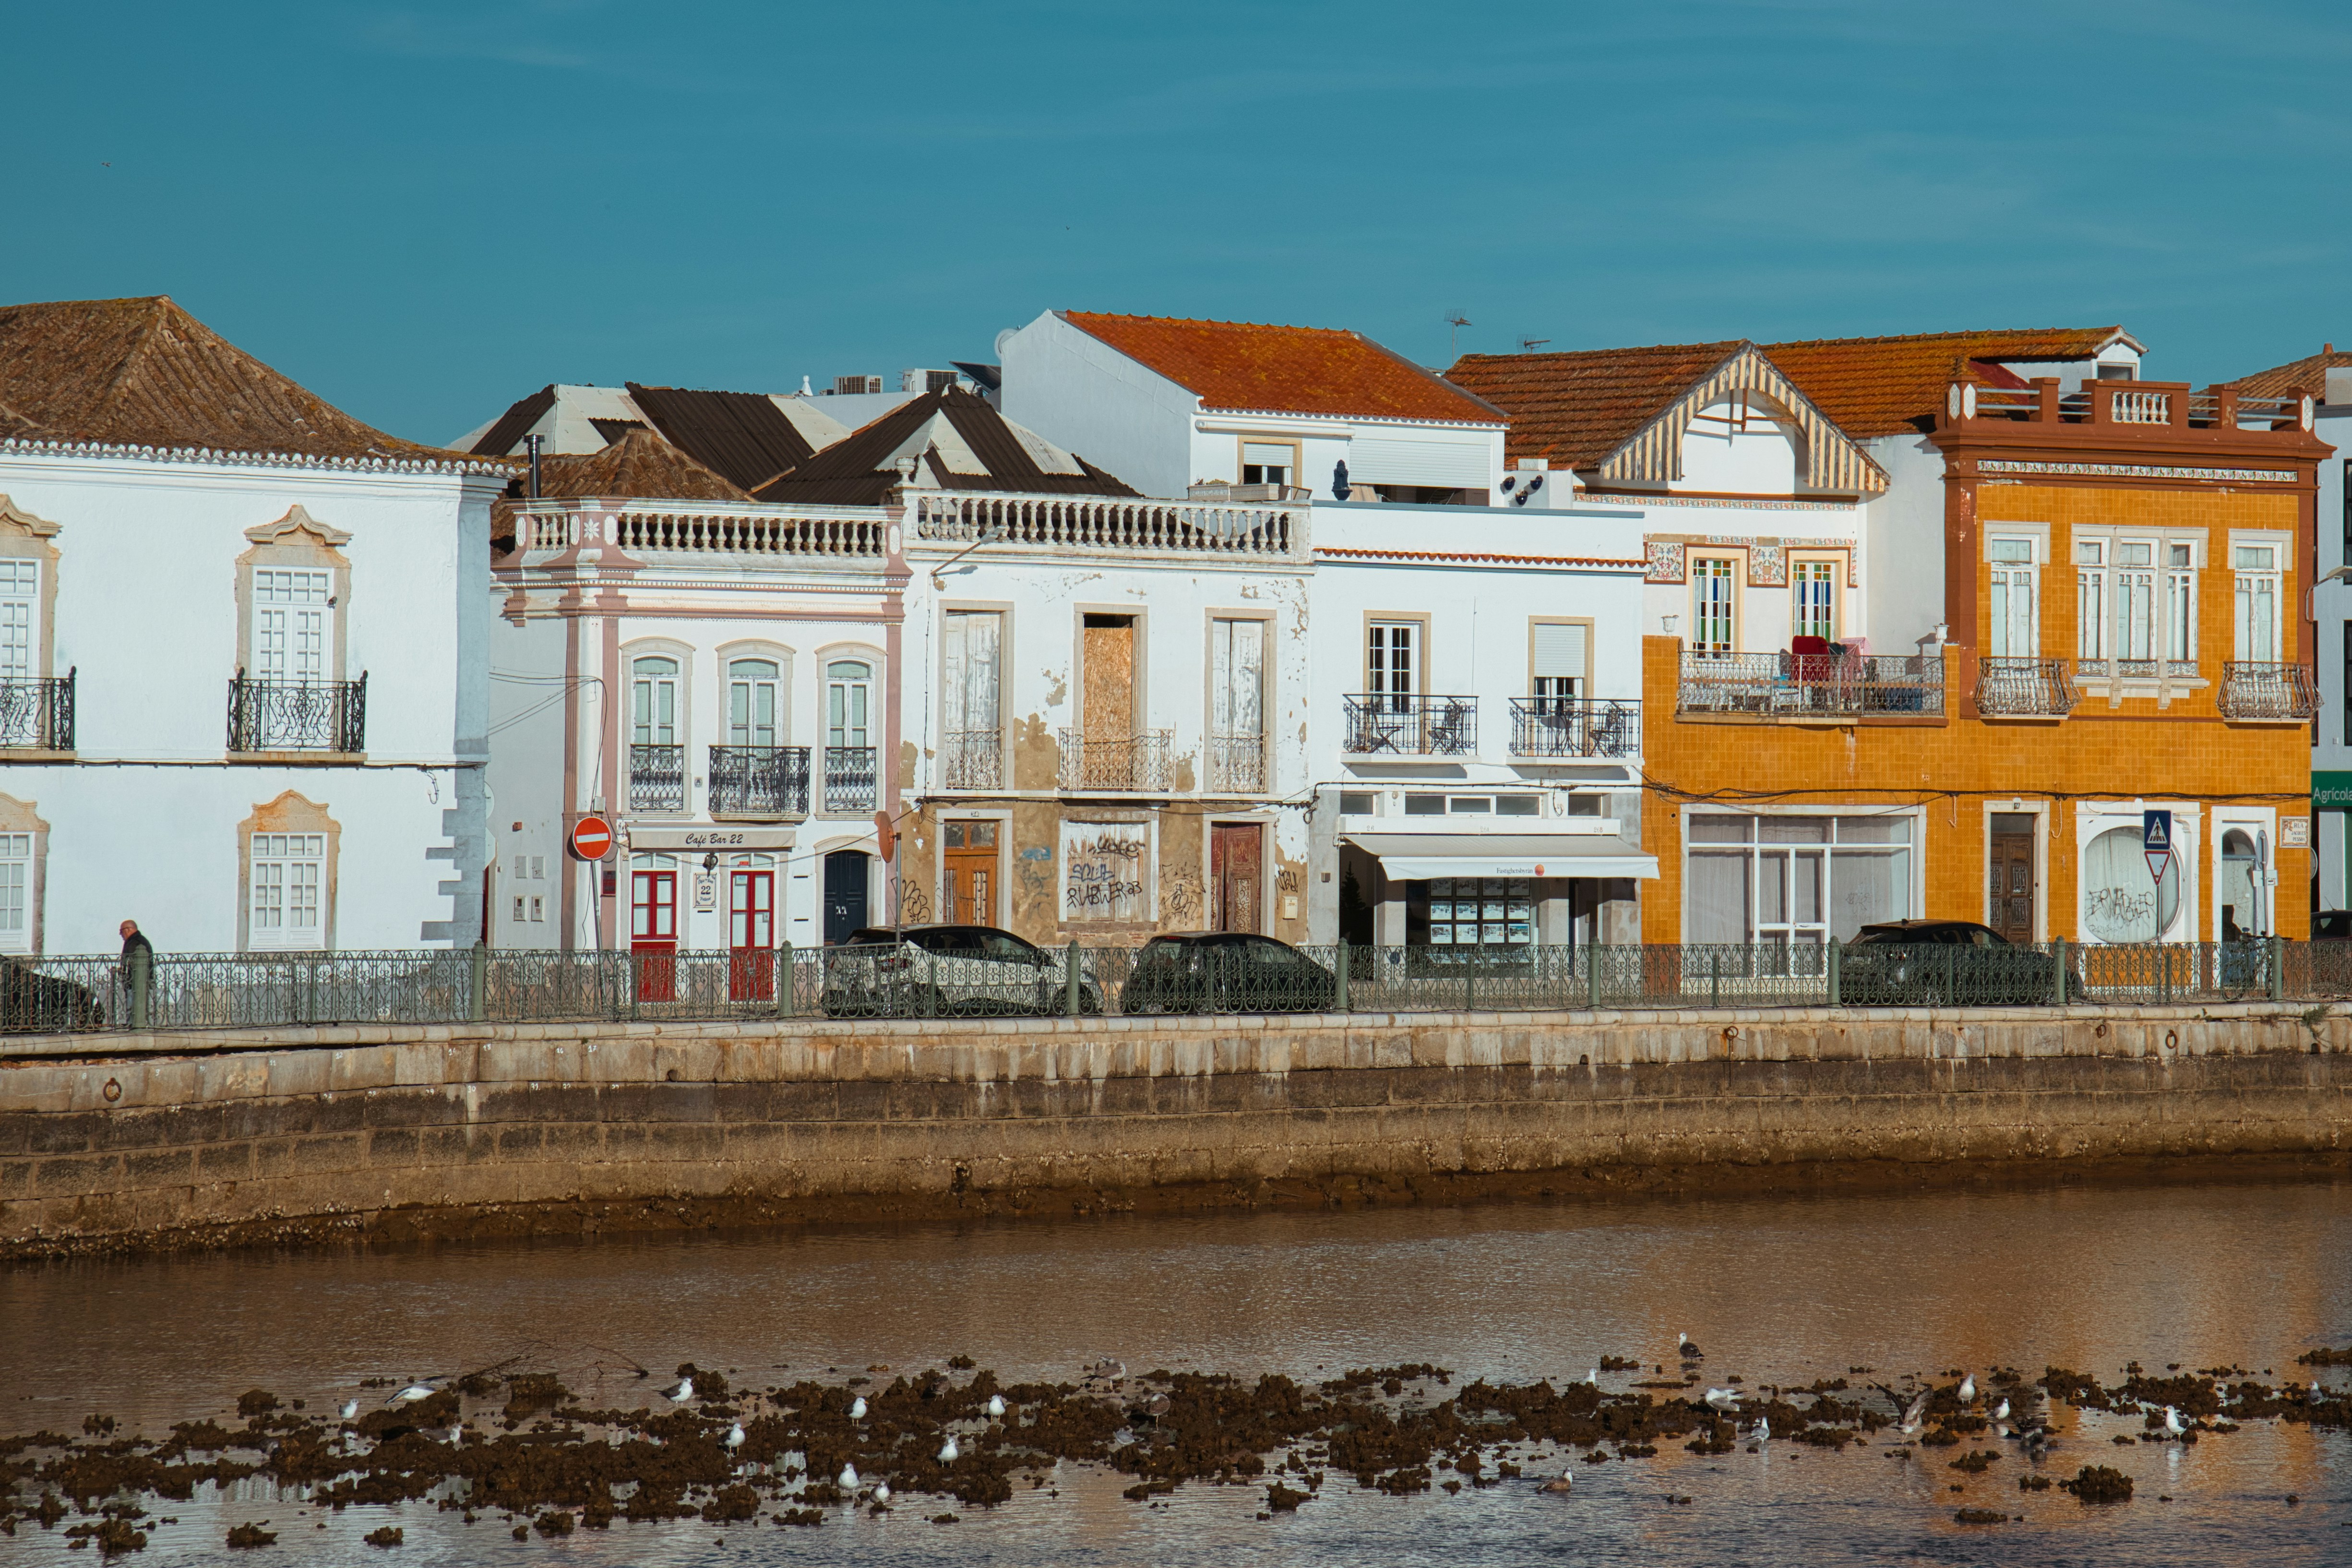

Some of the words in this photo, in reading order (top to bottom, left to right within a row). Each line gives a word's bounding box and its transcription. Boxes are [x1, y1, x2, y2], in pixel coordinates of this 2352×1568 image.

[686, 833, 706, 847] Café
[710, 833, 727, 844] Bar
[730, 834, 743, 844] 22
[701, 886, 711, 895] 22
[335, 1052, 343, 1060] 12
[468, 1085, 476, 1093] 30
